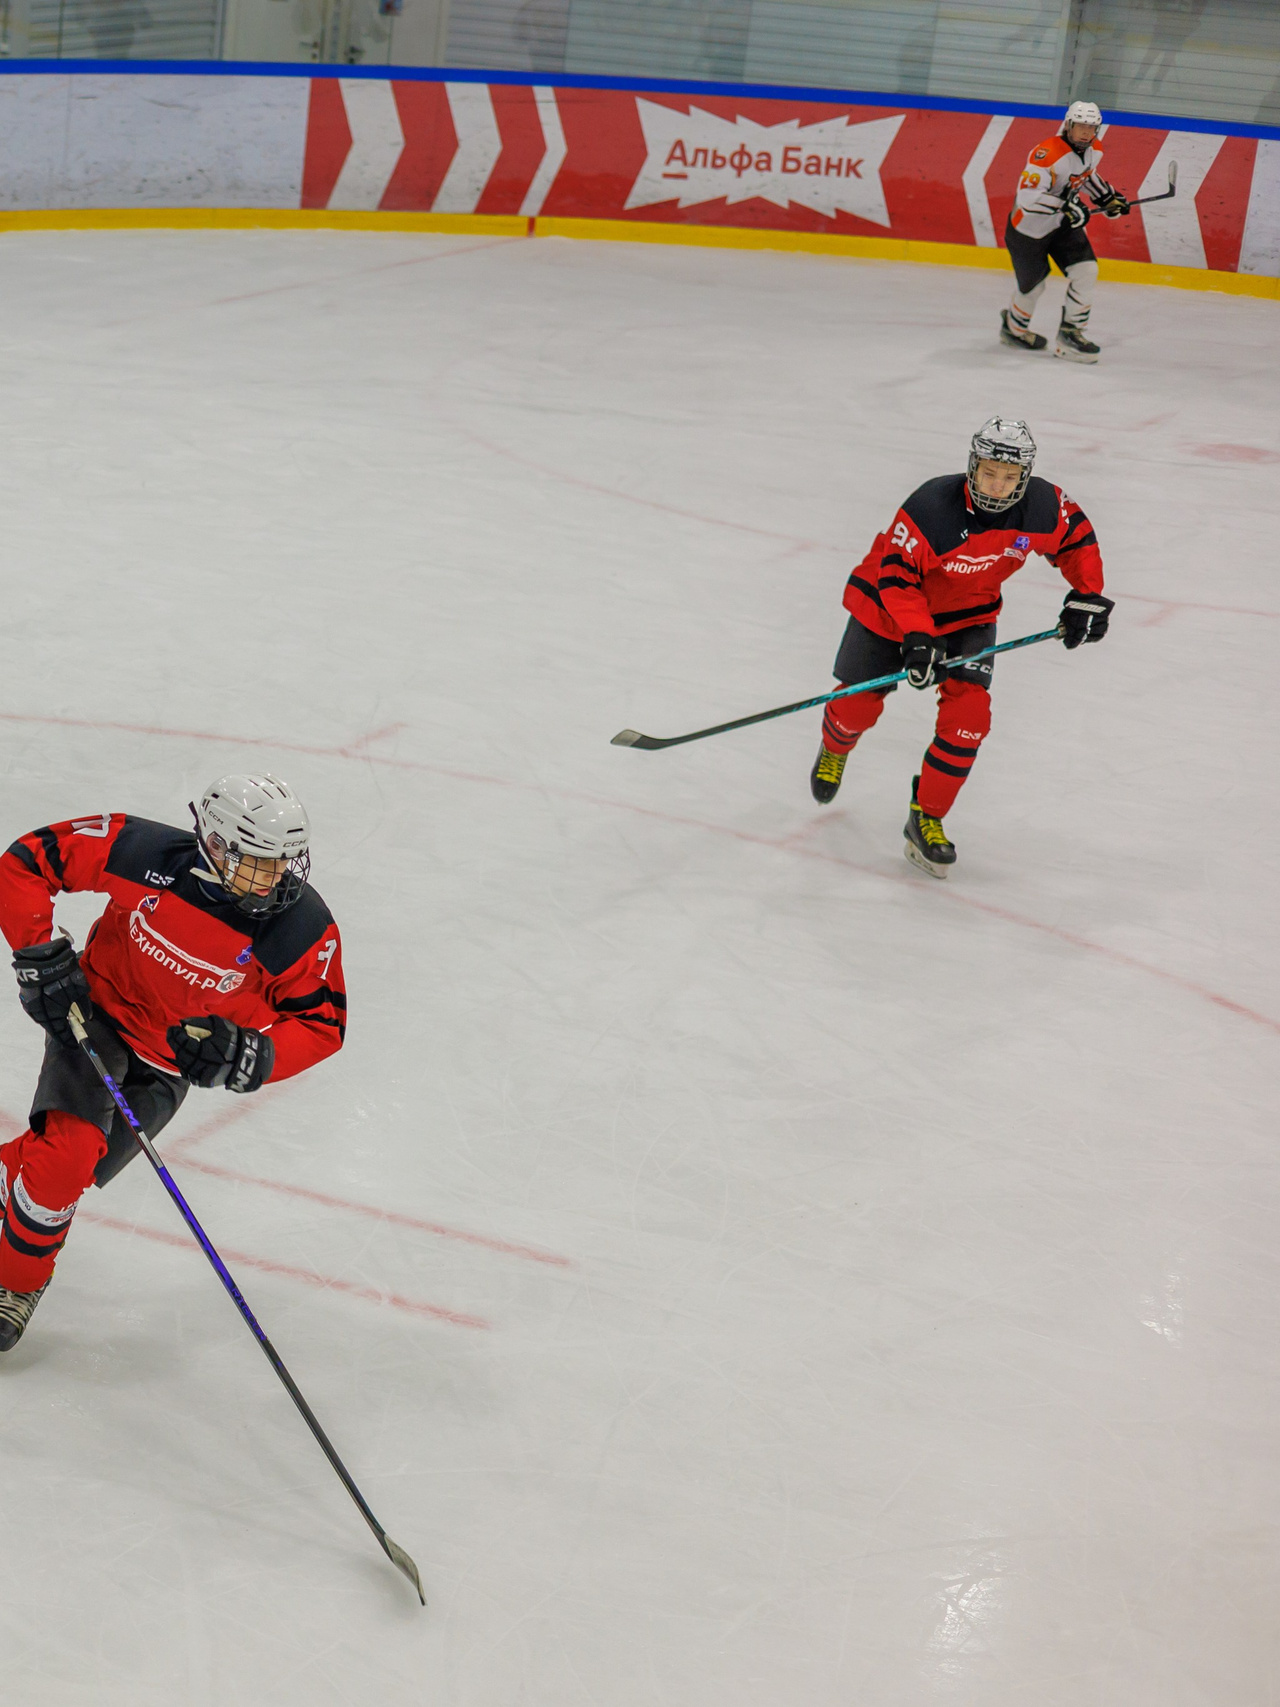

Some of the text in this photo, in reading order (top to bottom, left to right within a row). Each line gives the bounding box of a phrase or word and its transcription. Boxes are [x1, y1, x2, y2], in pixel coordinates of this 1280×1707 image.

[663, 138, 865, 179] Альфа Банк
[1020, 171, 1041, 190] 29
[208, 810, 224, 826] CCM
[282, 839, 307, 849] CCM
[229, 1030, 260, 1093] CCM
[103, 1074, 141, 1127] CCM
